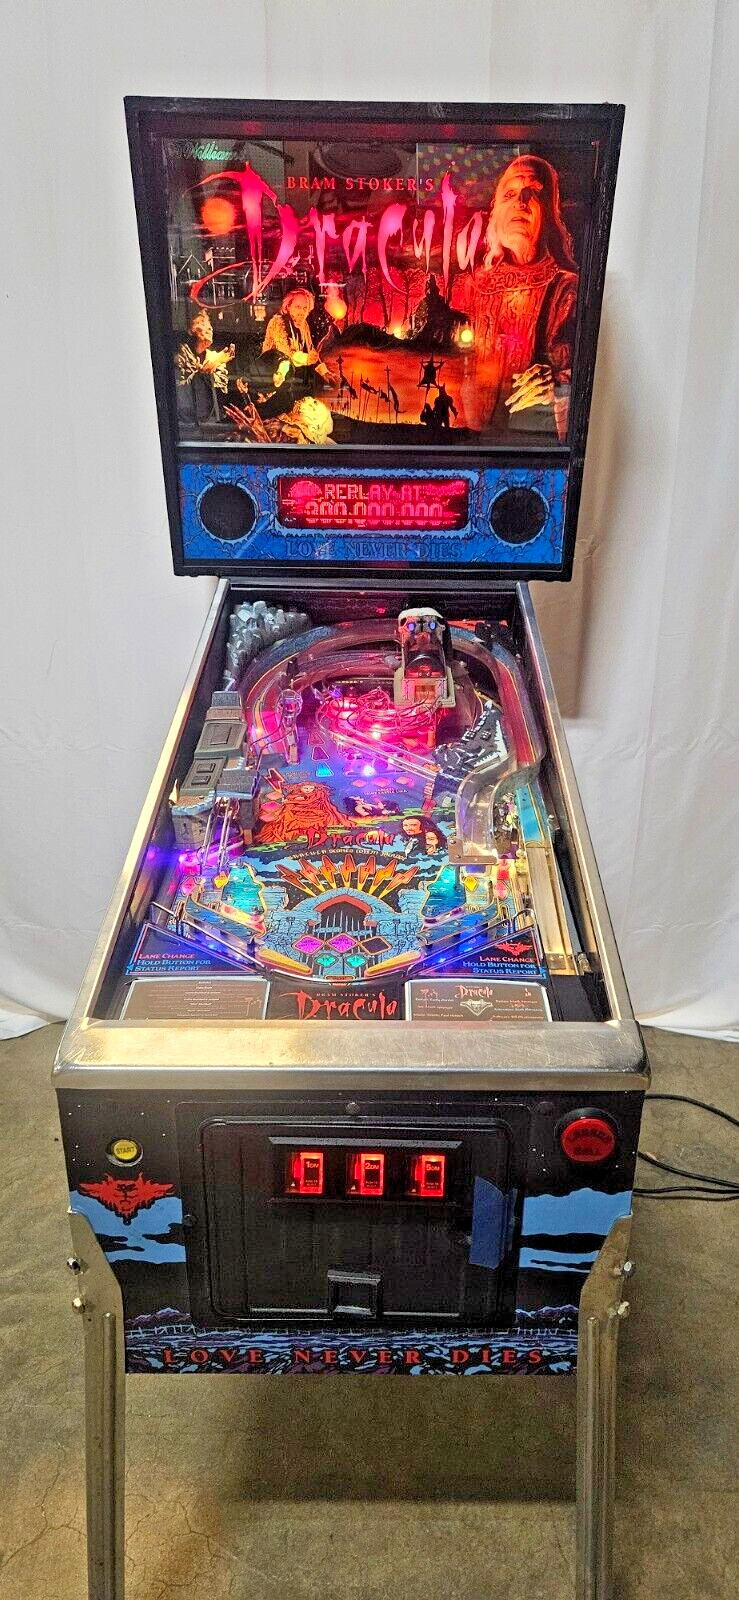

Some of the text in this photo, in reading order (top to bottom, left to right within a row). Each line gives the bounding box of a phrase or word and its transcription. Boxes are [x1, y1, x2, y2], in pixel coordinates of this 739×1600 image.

[286, 176, 434, 191] BRAM STOKER'S
[180, 160, 484, 307] Dracula
[324, 483, 421, 501] REPLAY AT
[286, 540, 463, 559] LOVE NEVER DIES
[306, 826, 396, 850] Dracula
[279, 990, 398, 1020] Dracula
[115, 1146, 136, 1155] START
[162, 1348, 542, 1365] LOVE NEVER DIES
